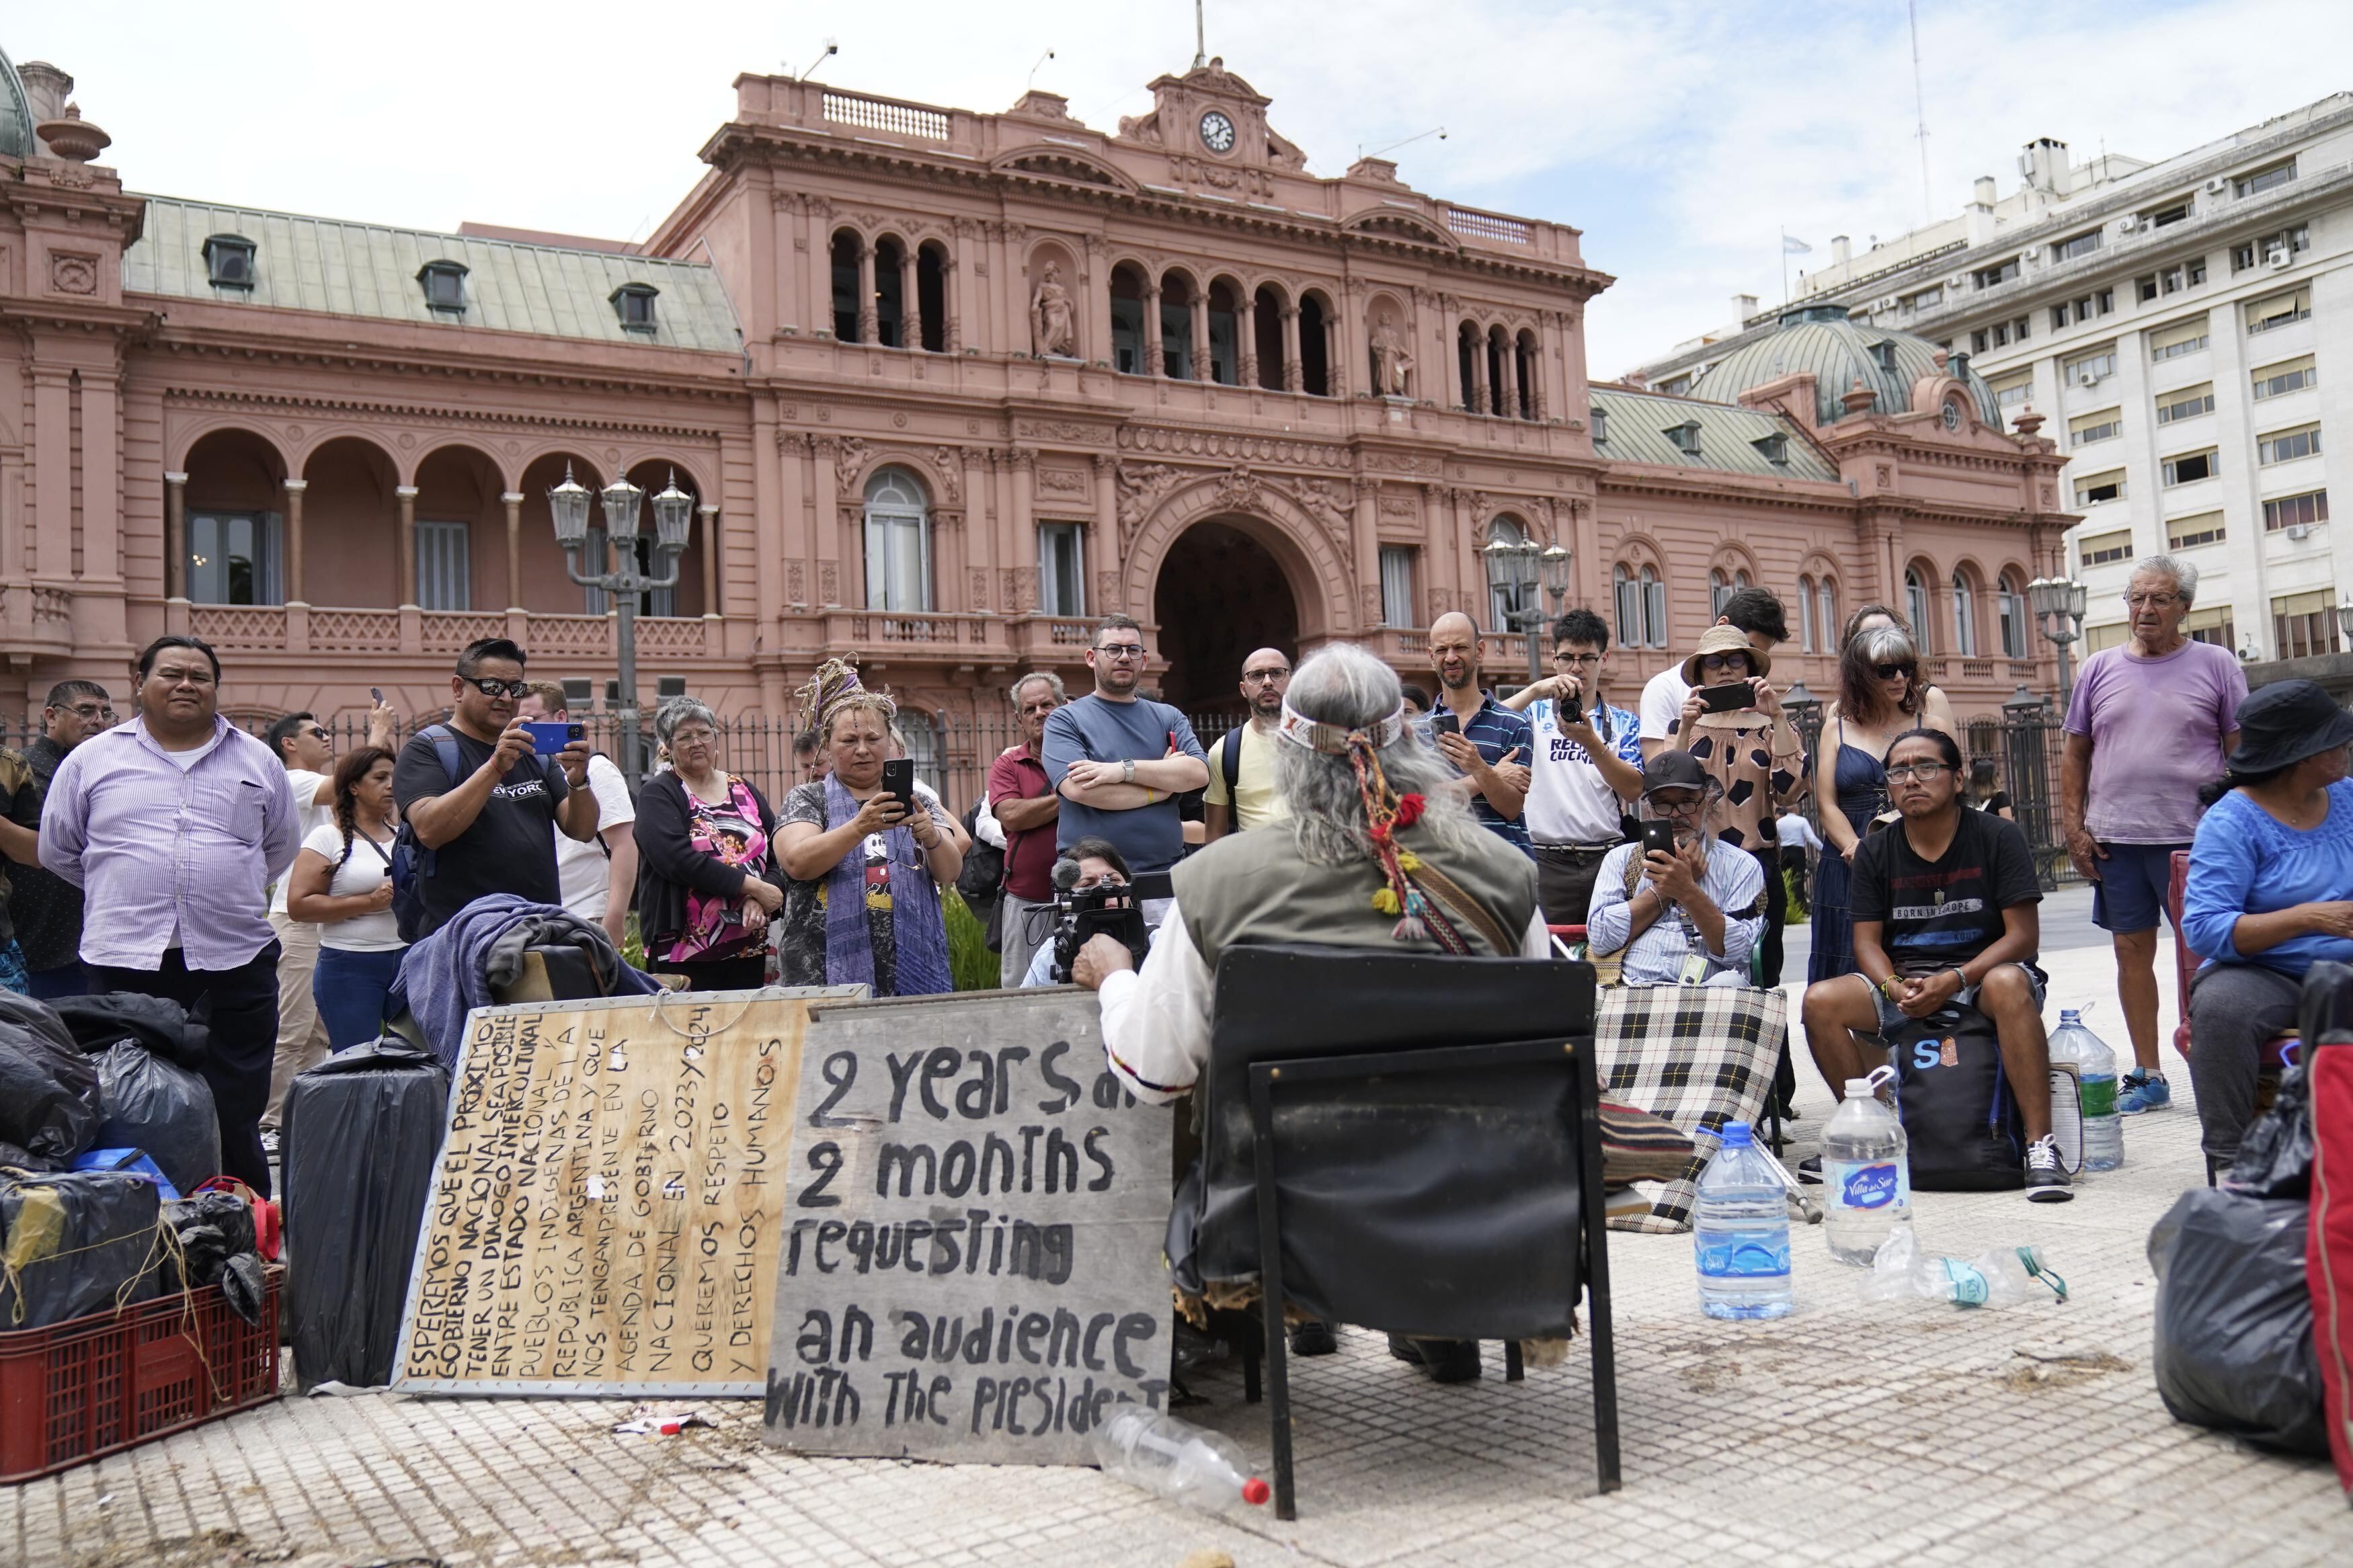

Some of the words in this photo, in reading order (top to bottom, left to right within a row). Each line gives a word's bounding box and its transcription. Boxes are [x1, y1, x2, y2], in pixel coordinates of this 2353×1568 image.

[1897, 909, 1923, 917] BORN
[1927, 907, 1936, 916] IN
[1938, 901, 1969, 915] EUROPE
[490, 1014, 518, 1079] POSIBLE
[556, 1026, 580, 1066] LA
[582, 1028, 605, 1077] QUE
[606, 1038, 629, 1073] LA
[680, 1058, 705, 1078] Y
[683, 1006, 711, 1058] 2024
[482, 1079, 509, 1122] SEA
[497, 1013, 544, 1159] INTERCULTURAL
[552, 1075, 574, 1103] DE
[581, 1083, 600, 1099] Y
[602, 1083, 623, 1112] EN
[669, 1080, 699, 1151] 2023
[740, 1038, 781, 1186] HUMANOS
[808, 1050, 859, 1128] 2
[444, 1143, 471, 1173] EL
[517, 1067, 553, 1188] NACIONAL
[631, 1089, 660, 1217] GOBIERNO
[704, 1102, 729, 1206] RESPETO
[439, 1178, 463, 1227] QUE
[458, 1127, 500, 1250] NACIONAL
[537, 1110, 569, 1253] INDIGENAS
[567, 1108, 594, 1237] ARGENTINA
[598, 1126, 620, 1232] PRESENTE
[662, 1170, 685, 1202] EN
[797, 1141, 844, 1208] 2
[1849, 1181, 1868, 1197] Villa
[1877, 1177, 1893, 1190] Sur
[481, 1164, 512, 1260] DIALOGO
[500, 1196, 529, 1290] ESTADO
[626, 1230, 645, 1257] DE
[407, 1234, 451, 1378] ESPEREMOS
[477, 1268, 496, 1301] UN
[590, 1235, 610, 1319] TENGAN
[649, 1219, 681, 1372] NACIONAL
[691, 1221, 725, 1372] QUEREMOS
[729, 1208, 765, 1347] DERECHOS
[435, 1260, 473, 1378] GOBIERNO
[465, 1306, 493, 1377] TENER
[491, 1301, 519, 1376] ENTRE
[520, 1266, 554, 1377] PUEBLOS
[582, 1331, 607, 1377] NOS
[616, 1272, 643, 1372] AGENDA
[795, 1303, 874, 1364] an
[900, 1304, 1157, 1378] audience
[729, 1358, 756, 1374] Y
